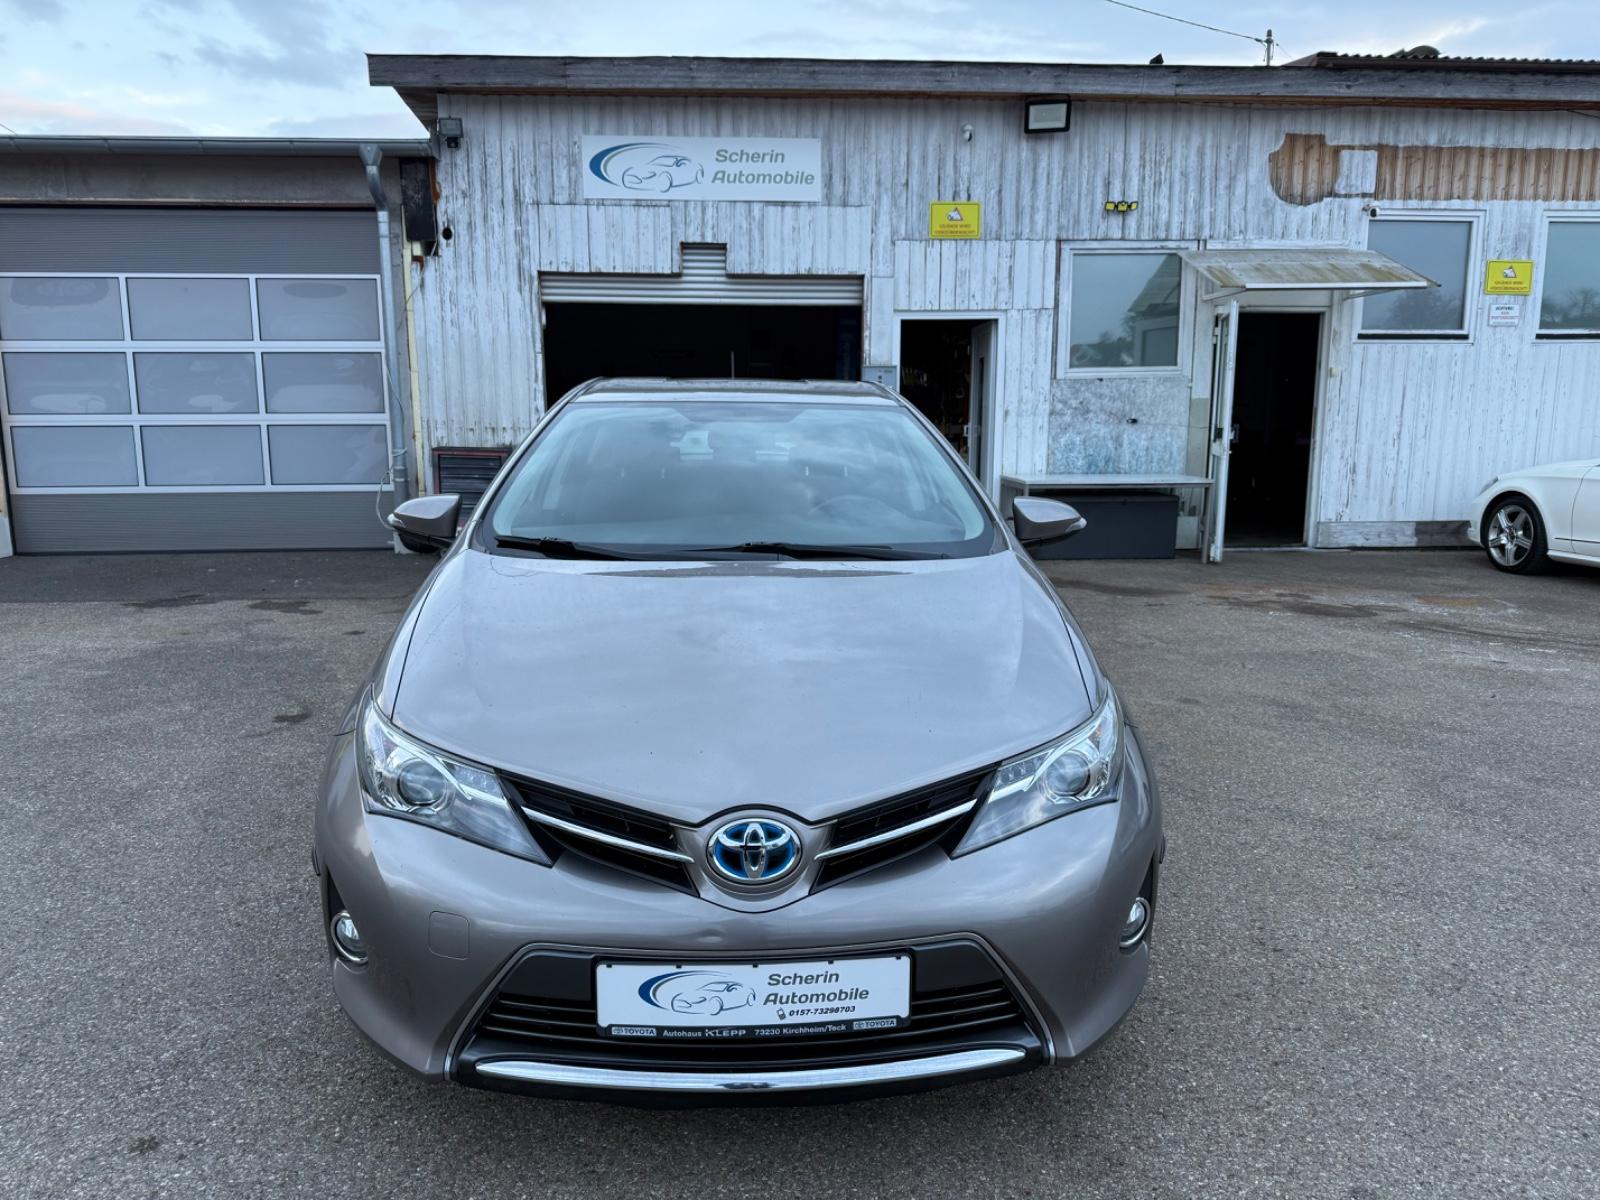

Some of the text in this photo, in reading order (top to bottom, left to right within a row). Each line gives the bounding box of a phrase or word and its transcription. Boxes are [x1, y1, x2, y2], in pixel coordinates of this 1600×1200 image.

[715, 149, 785, 163] Scherin
[711, 170, 815, 185] Automobile
[767, 970, 840, 986] Scherin
[763, 988, 870, 1006] Automobile
[624, 1018, 896, 1038] TOYOTA Autohaus KLEPP 73230 Kirchheim/Teck TOYOTA
